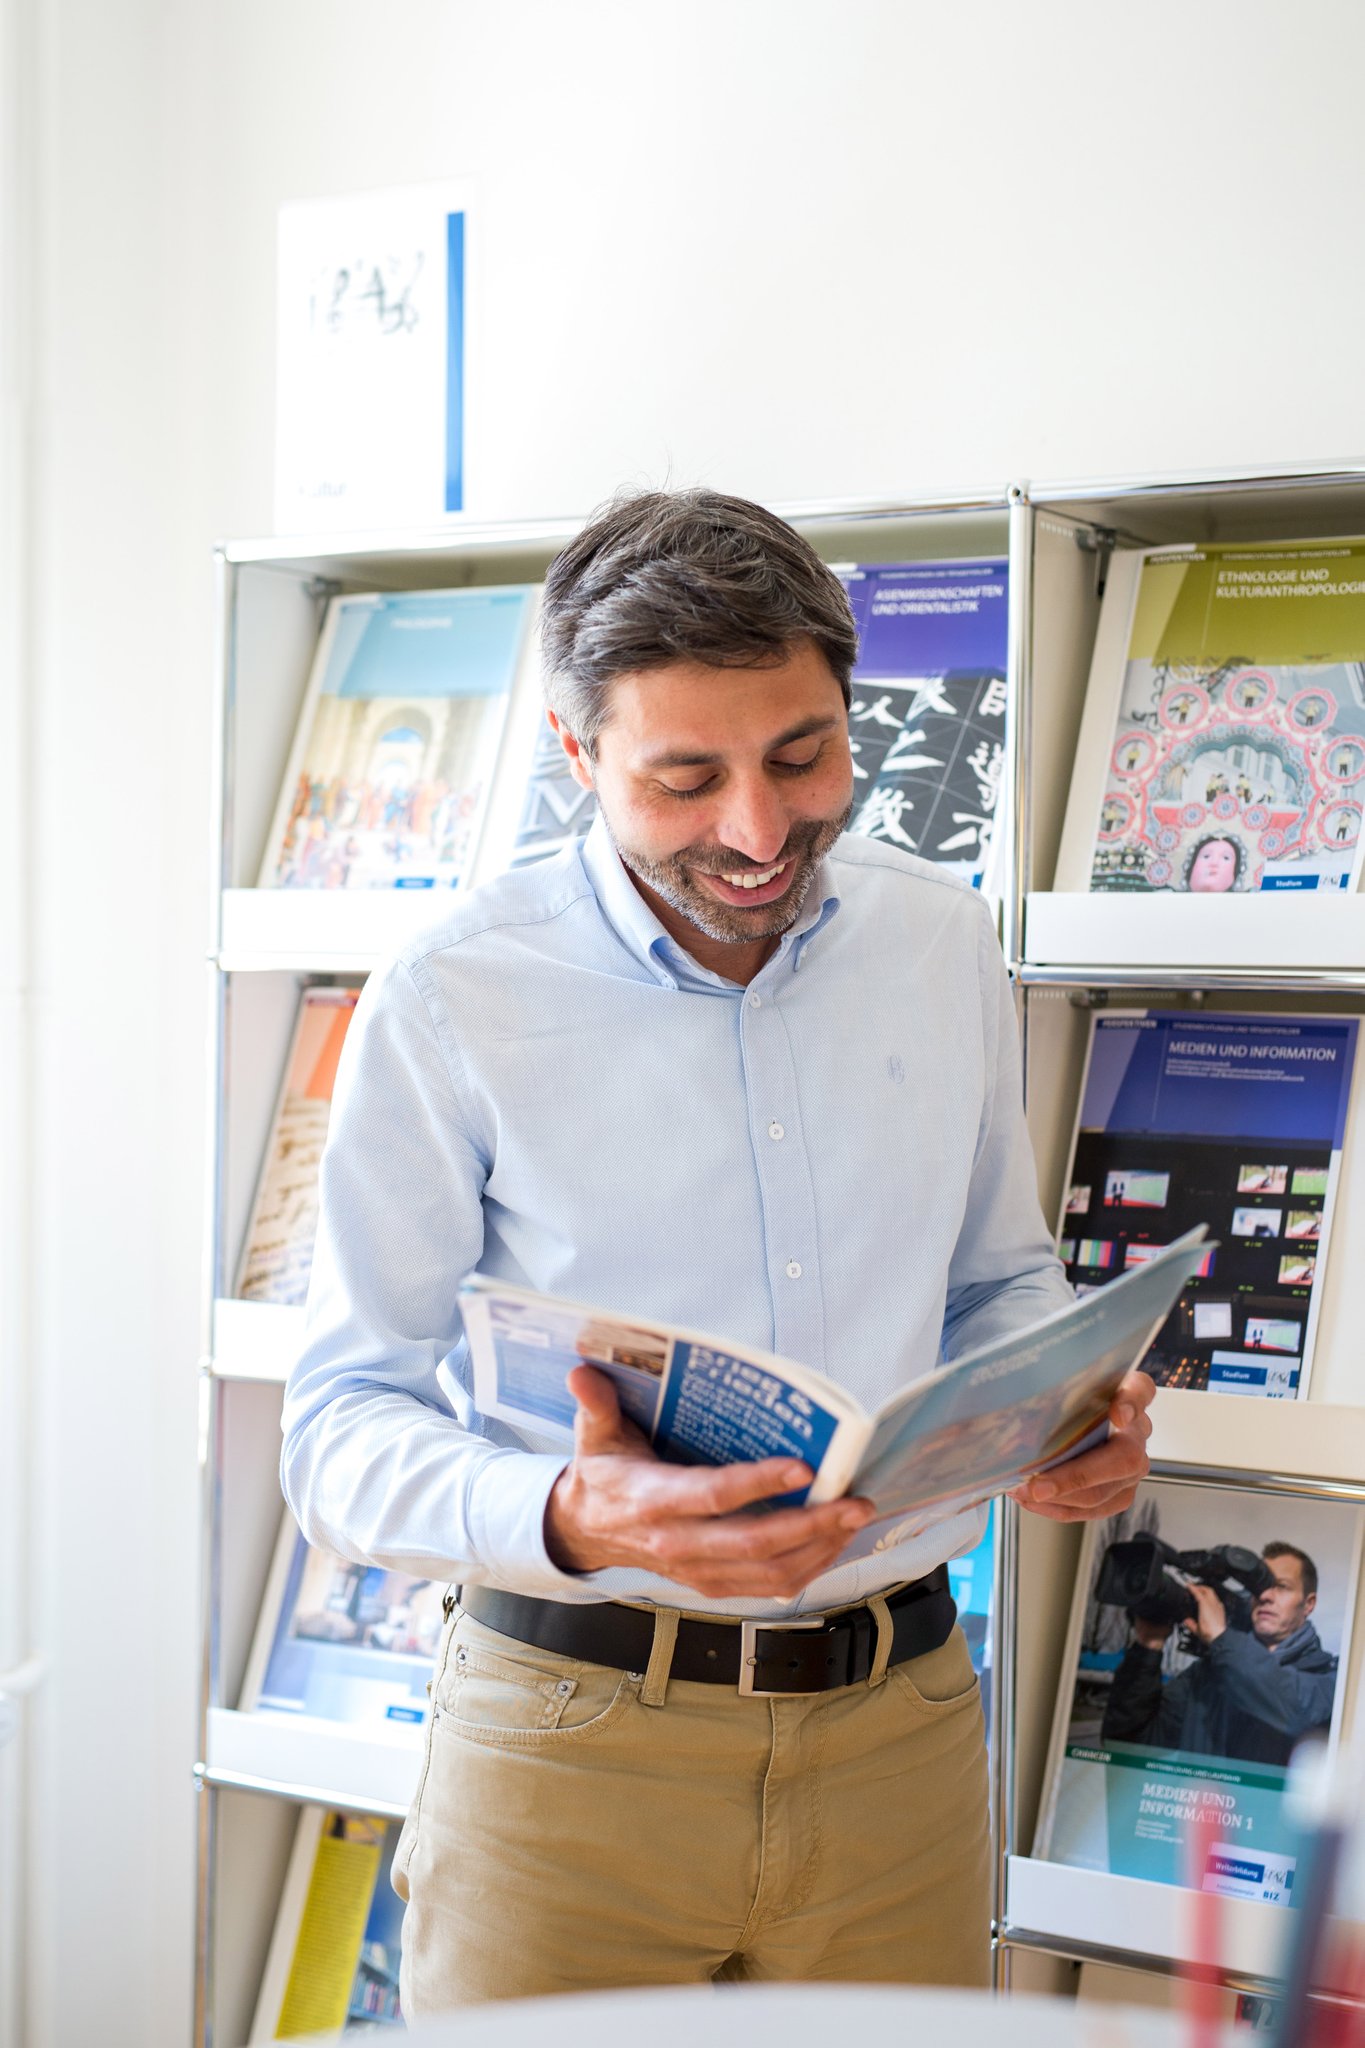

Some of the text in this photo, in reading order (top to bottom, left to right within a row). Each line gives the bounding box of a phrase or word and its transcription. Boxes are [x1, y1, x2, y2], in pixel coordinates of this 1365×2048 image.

[1218, 567, 1329, 584] ETHNOLOGIE UND
[872, 602, 898, 616] UND
[1169, 1041, 1337, 1061] MEDIEN UND INFORMATION
[1222, 1369, 1250, 1380] Studium
[1071, 1748, 1112, 1762] CHANCEN
[1142, 1783, 1235, 1809] MEDIEN UND
[1139, 1799, 1242, 1828] INFORMATION
[1246, 1817, 1254, 1831] 1
[1215, 1861, 1258, 1879] Weiterbildung
[1263, 1890, 1279, 1901] BIZ
